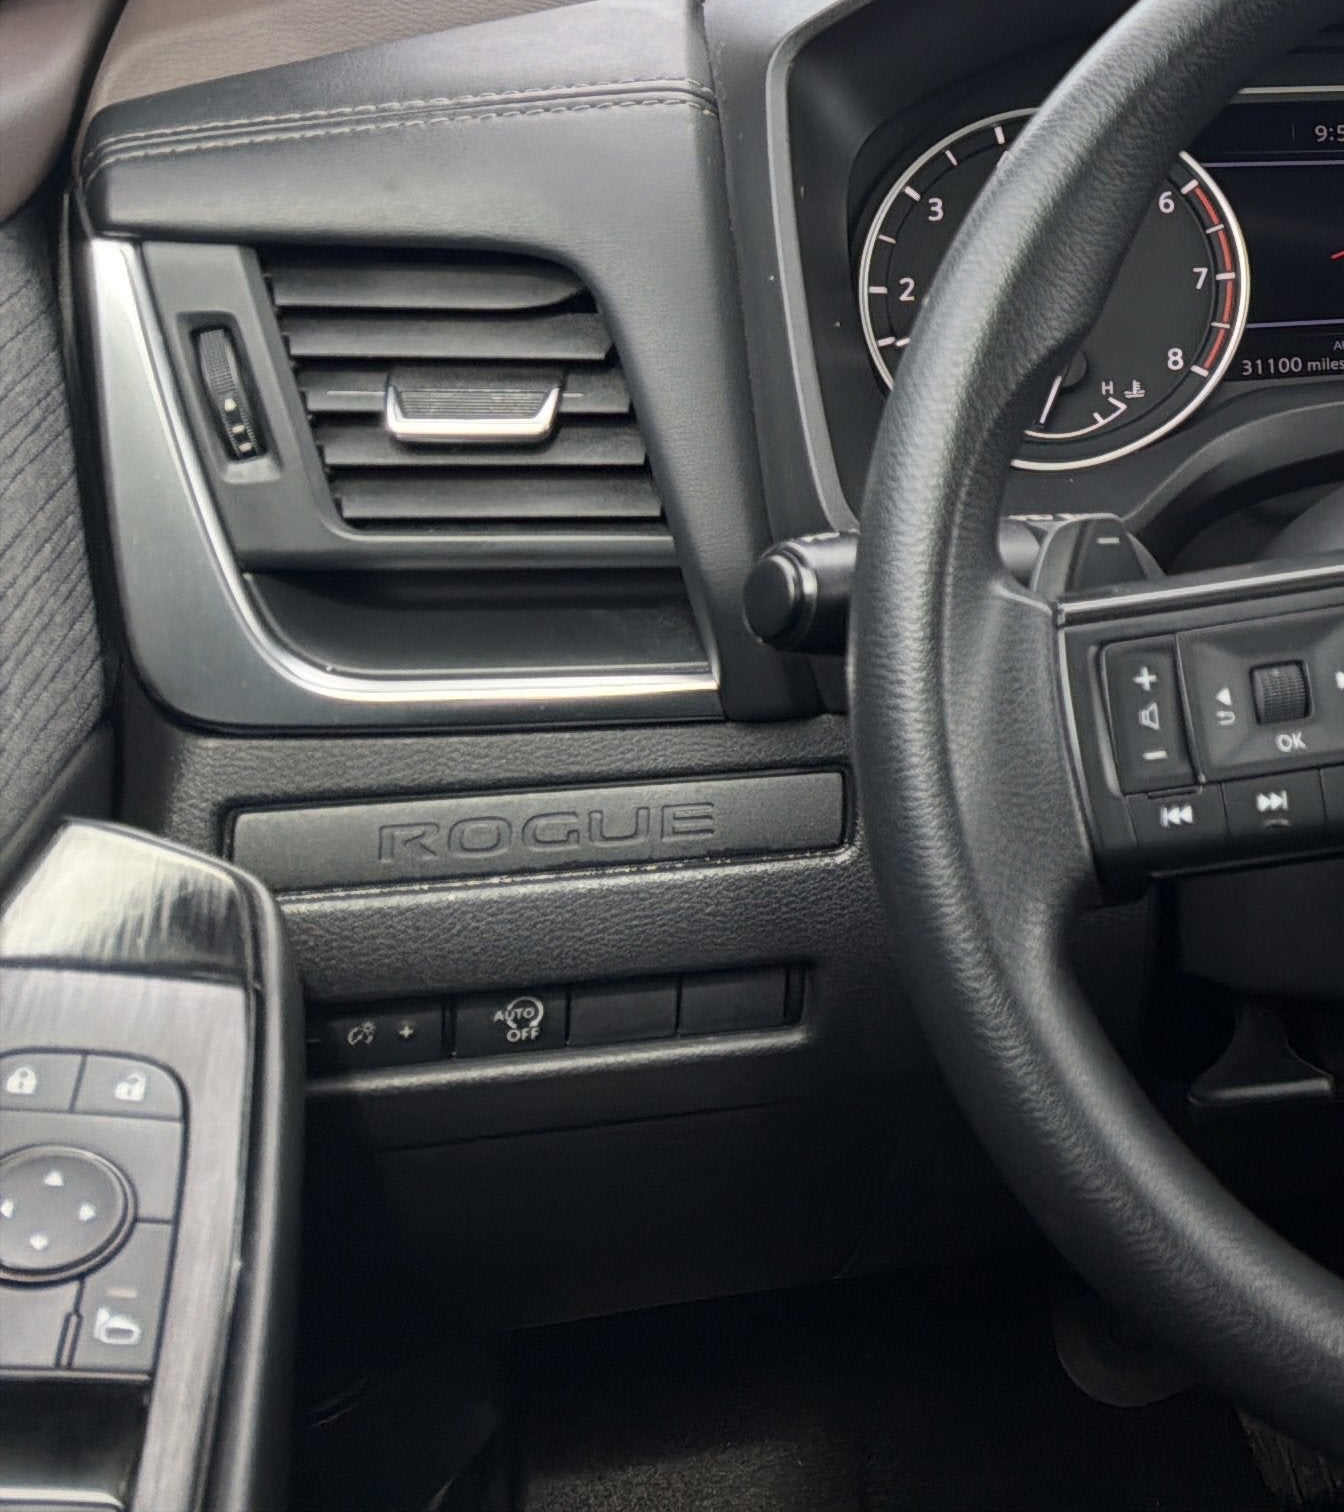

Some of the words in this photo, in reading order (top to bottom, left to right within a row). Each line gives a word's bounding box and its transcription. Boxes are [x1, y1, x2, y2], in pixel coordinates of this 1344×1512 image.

[928, 198, 944, 221] 3
[1158, 191, 1175, 214] 6
[899, 277, 915, 301] 2
[1192, 267, 1208, 290] 7
[1167, 348, 1184, 370] 8
[1241, 356, 1302, 376] 31100
[1102, 381, 1114, 396] H
[1276, 732, 1307, 753] OK
[377, 801, 716, 865] ROGUE
[493, 1006, 536, 1023] AUTO
[506, 1027, 540, 1043] OFF
